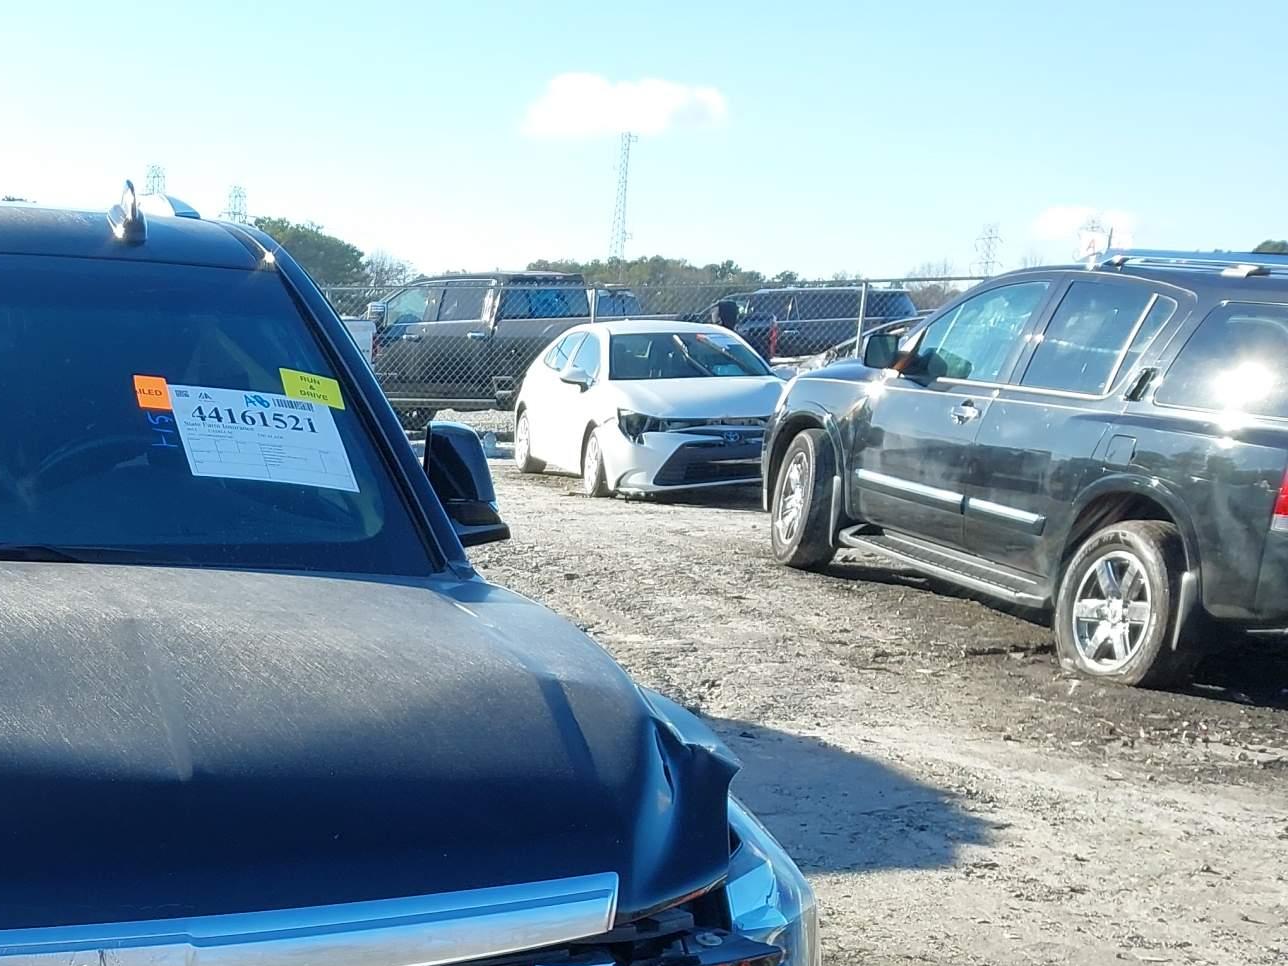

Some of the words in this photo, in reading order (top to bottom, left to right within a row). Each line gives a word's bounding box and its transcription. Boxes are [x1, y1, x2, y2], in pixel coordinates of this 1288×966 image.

[299, 375, 321, 385] RUN
[299, 390, 329, 401] DRIVE
[191, 405, 320, 434] 44161521
